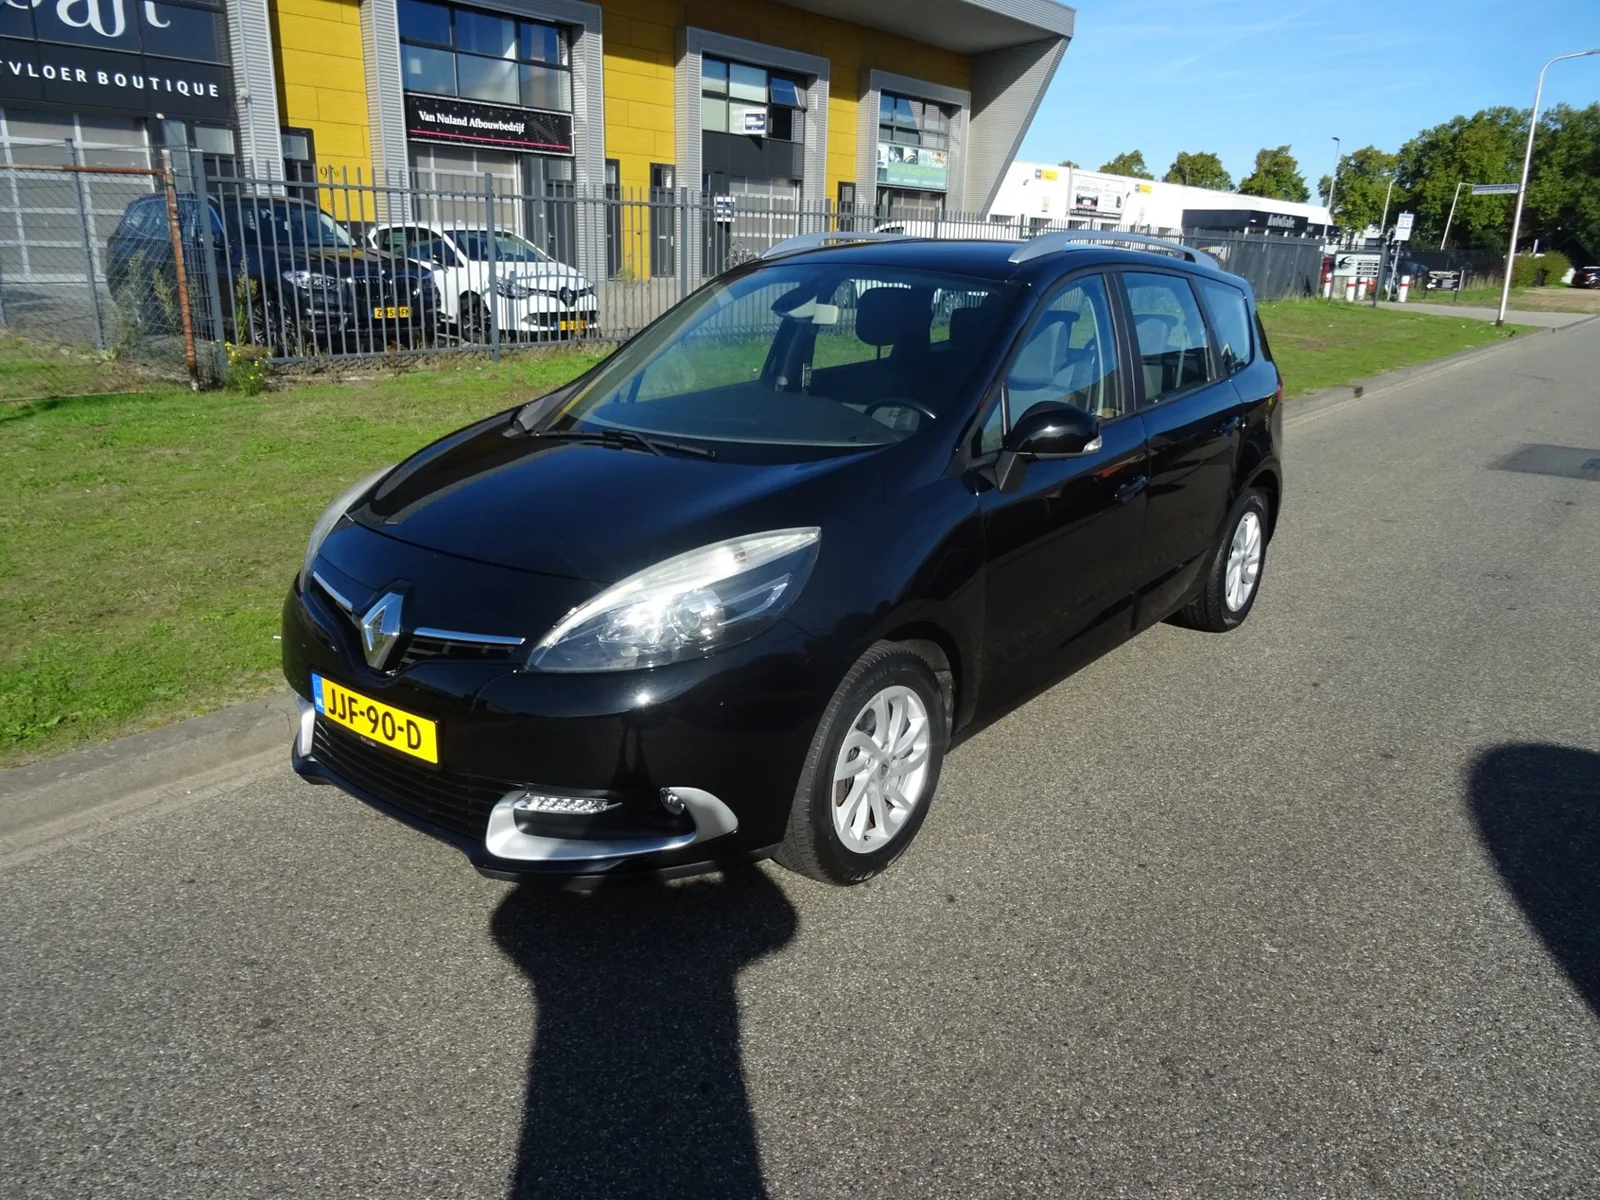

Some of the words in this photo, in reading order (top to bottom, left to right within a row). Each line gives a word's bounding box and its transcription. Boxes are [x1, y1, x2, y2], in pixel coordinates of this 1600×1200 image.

[97, 71, 219, 98] BOUTIQUE
[418, 110, 435, 123] Van
[436, 113, 467, 127] Nuland
[469, 118, 525, 135] Afbouwbedrijf
[328, 688, 422, 750] JJF-90-D
